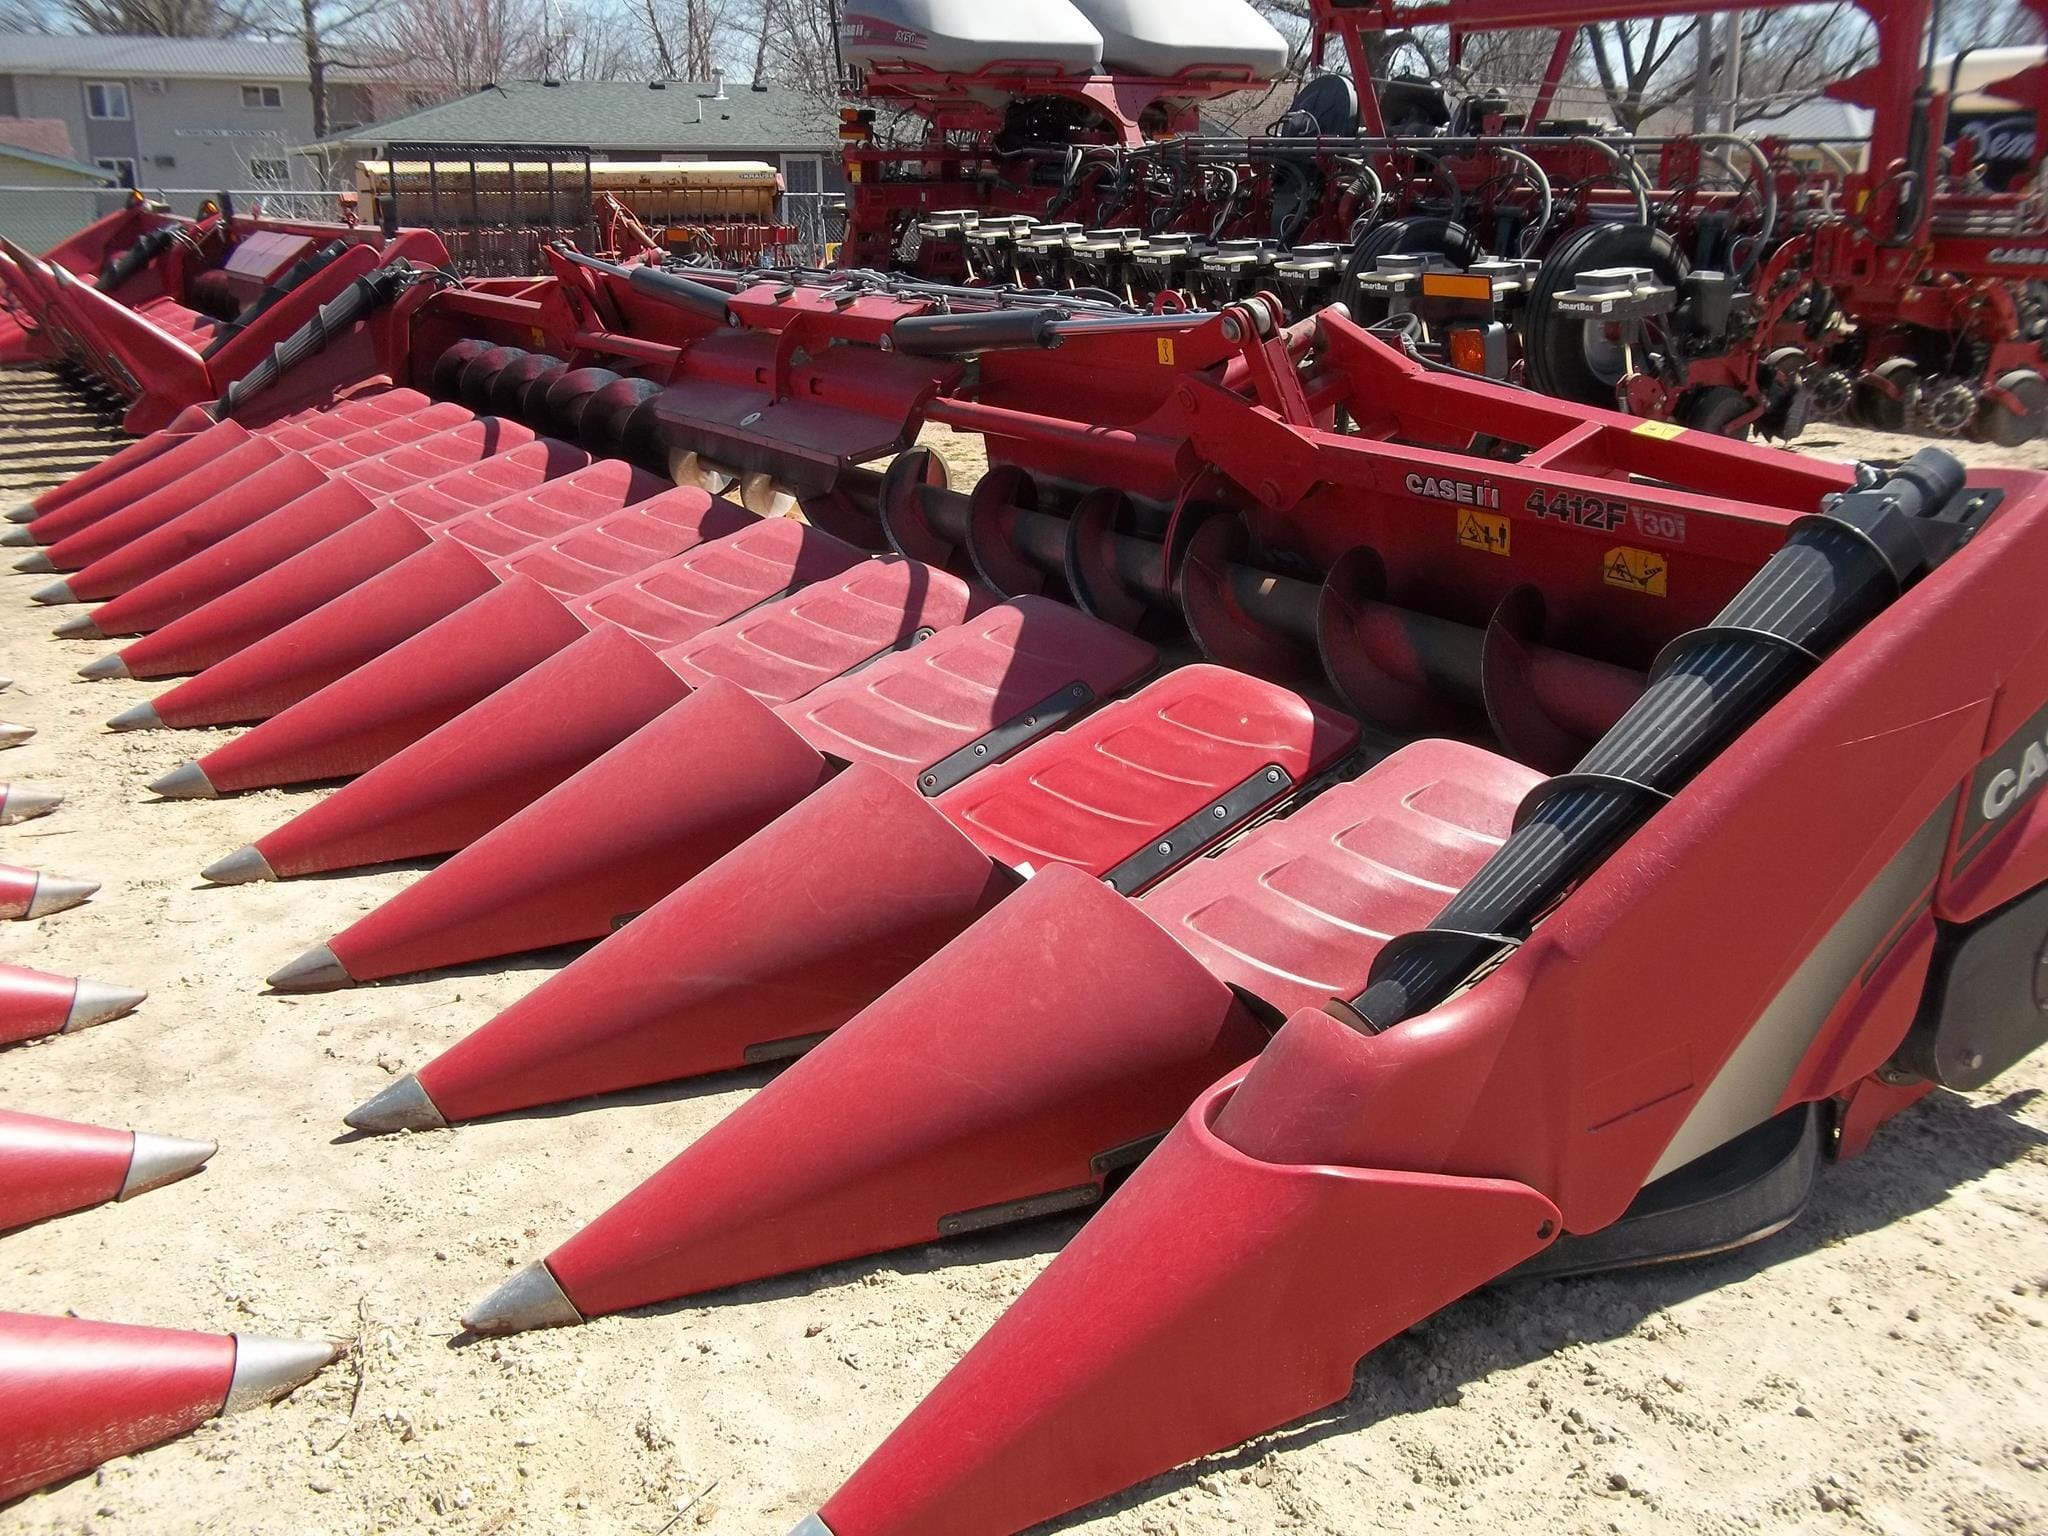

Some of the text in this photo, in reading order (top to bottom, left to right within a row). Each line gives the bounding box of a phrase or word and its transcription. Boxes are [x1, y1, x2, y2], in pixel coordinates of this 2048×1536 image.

[1203, 263, 1226, 272] SmartBox
[1279, 269, 1305, 279] SmartBox
[1359, 281, 1388, 291] SmartBox
[1557, 300, 1594, 312] SmartBox
[1524, 487, 1629, 533] 4412F
[1643, 513, 1676, 538] 30
[1983, 731, 2048, 819] CA
